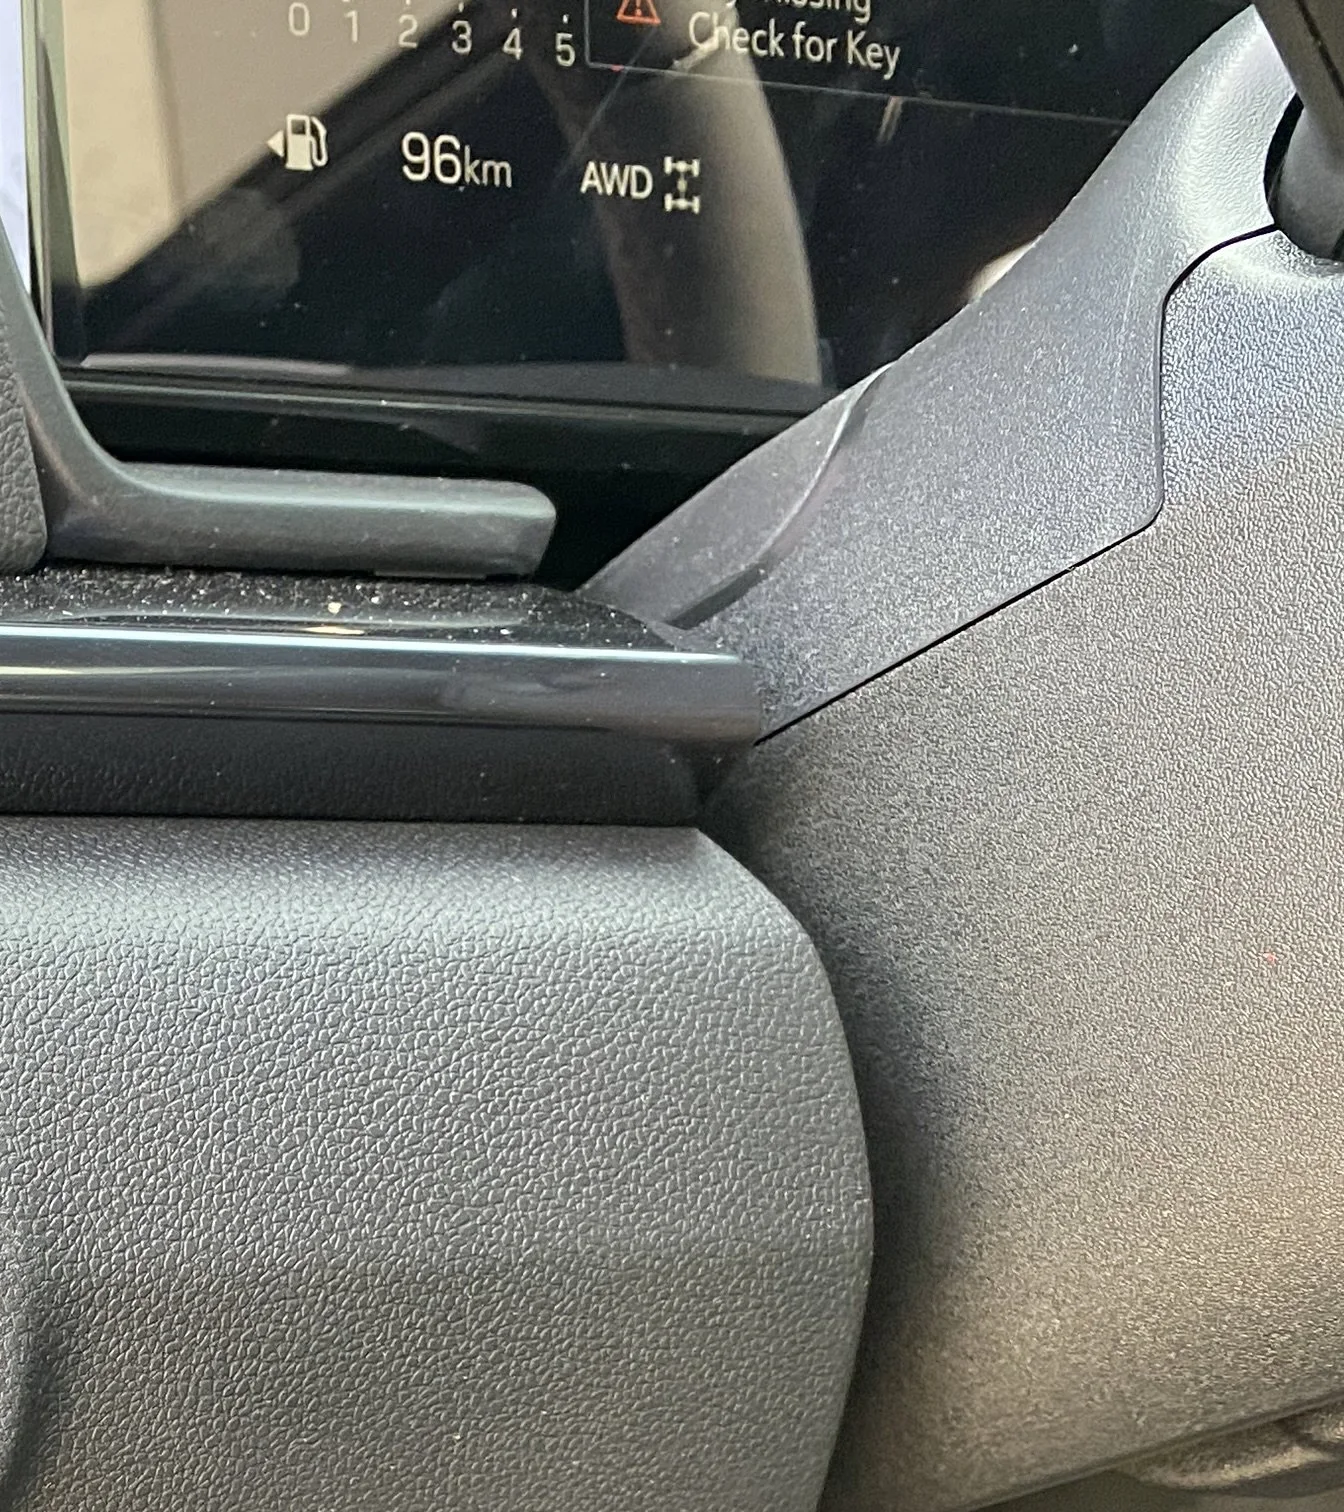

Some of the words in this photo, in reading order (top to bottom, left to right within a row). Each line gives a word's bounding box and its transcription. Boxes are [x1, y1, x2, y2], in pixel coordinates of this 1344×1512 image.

[288, 2, 310, 36] 0
[344, 10, 359, 43] 1
[398, 14, 418, 48] 2
[452, 20, 472, 54] 3
[502, 27, 523, 60] 4
[555, 32, 576, 67] 5
[688, 11, 785, 58] Check
[792, 21, 838, 63] for
[847, 29, 902, 80] Key
[401, 131, 512, 188] 96km
[580, 160, 653, 199] AWD
